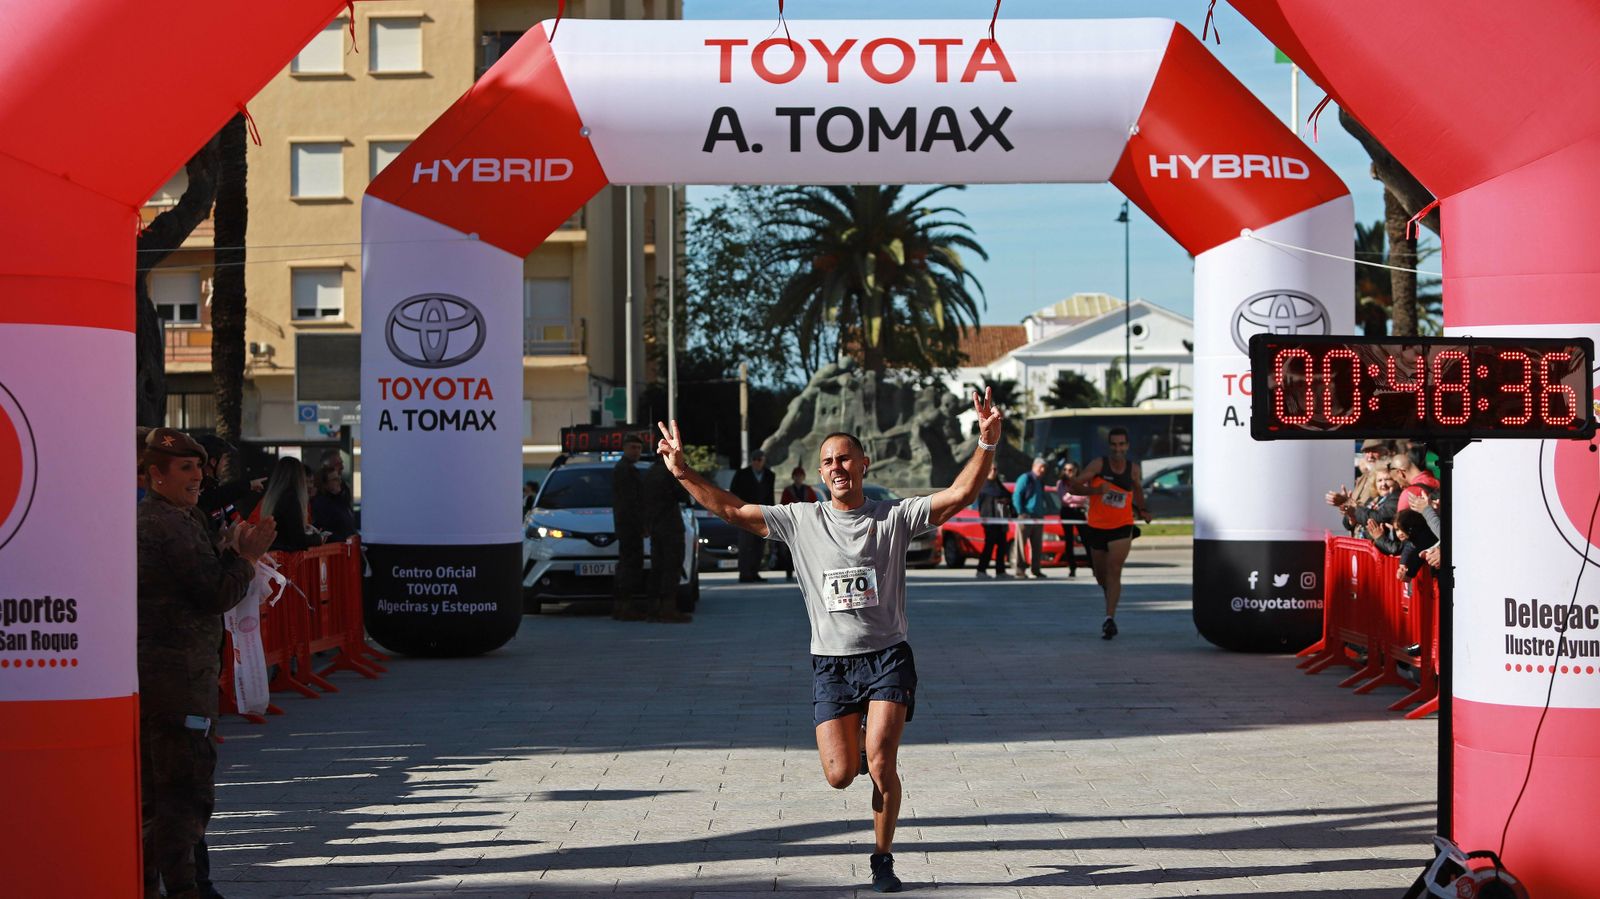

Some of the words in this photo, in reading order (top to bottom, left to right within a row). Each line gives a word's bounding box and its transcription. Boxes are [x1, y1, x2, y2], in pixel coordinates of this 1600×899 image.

[704, 37, 1017, 85] TOYOTA
[702, 106, 763, 154] A.
[775, 106, 1015, 154] TOMAX
[412, 158, 574, 184] HYBRID
[1149, 154, 1310, 180] HYBRID
[378, 377, 494, 400] TOYOTA
[1274, 348, 1576, 426] 00:48:36
[379, 409, 399, 431] A.
[402, 409, 497, 431] TOMAX
[1223, 405, 1245, 427] A.
[392, 566, 433, 578] Centro
[436, 566, 477, 578] Oficial
[582, 564, 605, 574] 9107
[407, 583, 458, 595] TOYOTA
[831, 577, 868, 595] 170
[0, 596, 78, 627] portes
[377, 600, 428, 614] Algeciras
[431, 603, 439, 615] y
[442, 601, 497, 615] Estepona
[1231, 597, 1324, 612] @toyotatoma
[1504, 598, 1599, 633] Delegac
[31, 630, 79, 653] Roque
[1505, 634, 1555, 657] Ilustre
[1558, 636, 1600, 660] Ayun
